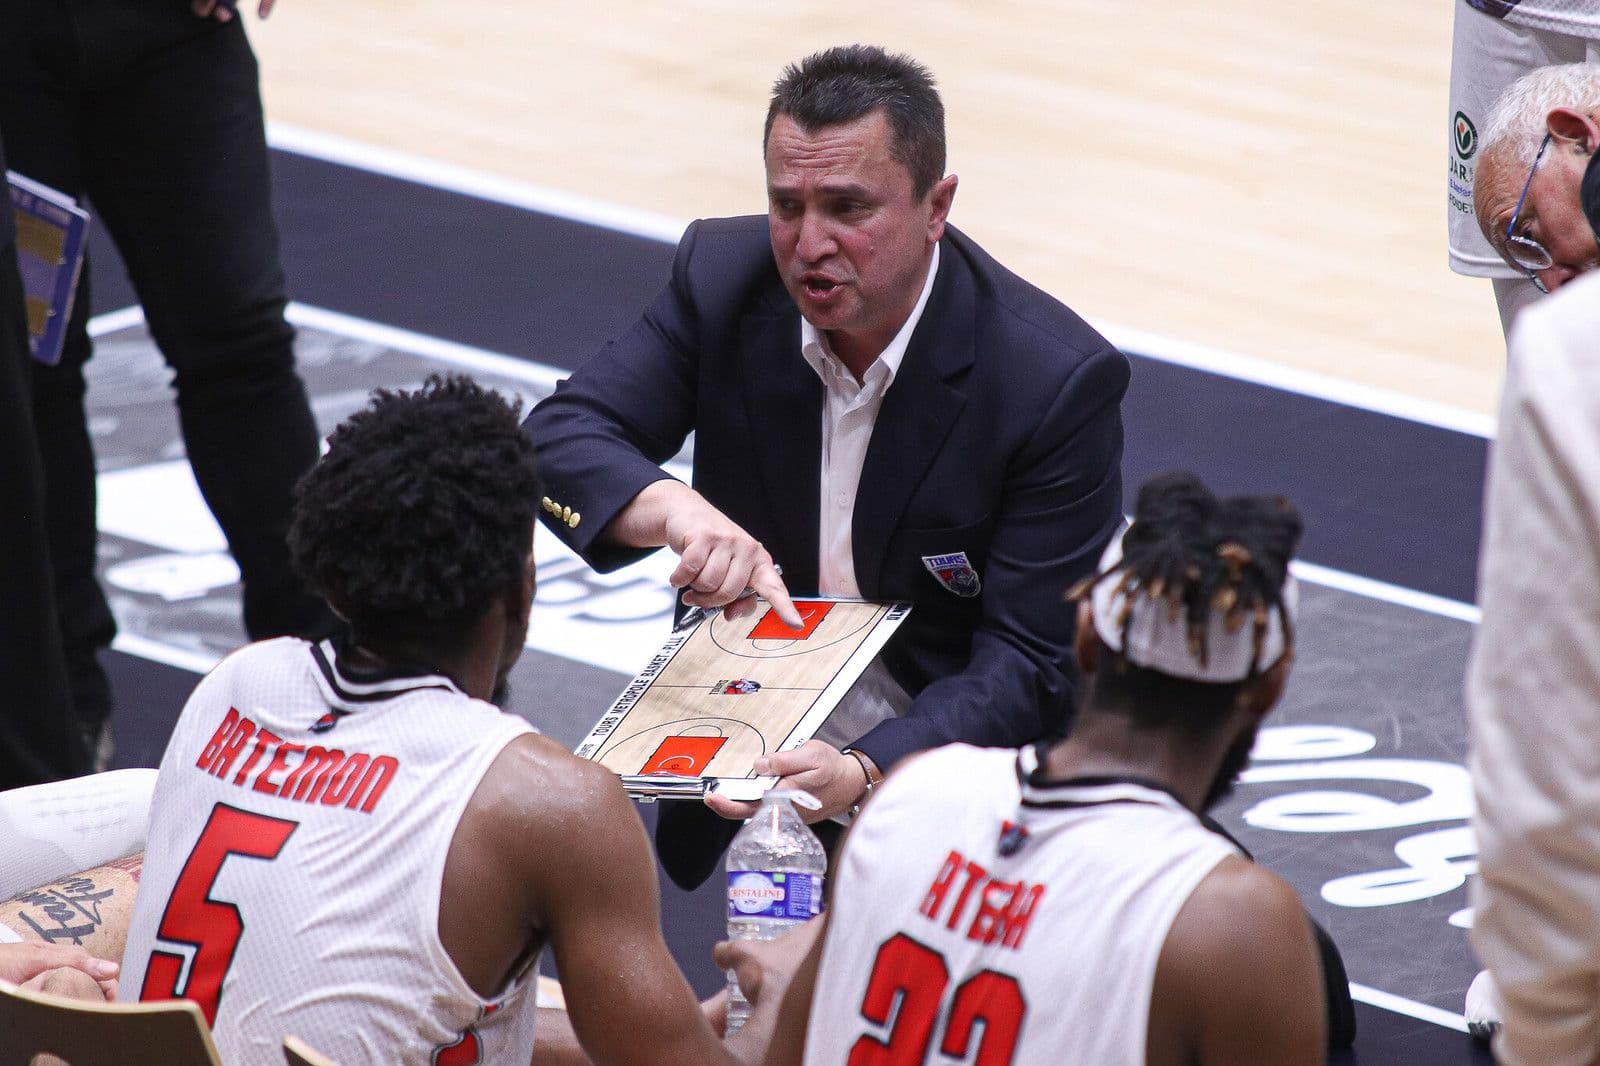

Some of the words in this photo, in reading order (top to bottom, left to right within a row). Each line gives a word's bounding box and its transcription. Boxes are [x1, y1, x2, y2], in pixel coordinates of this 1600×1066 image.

[591, 716, 619, 736] TOURS
[610, 679, 650, 714] METROPOLE
[640, 654, 670, 677] BASKET
[139, 801, 300, 1031] 5
